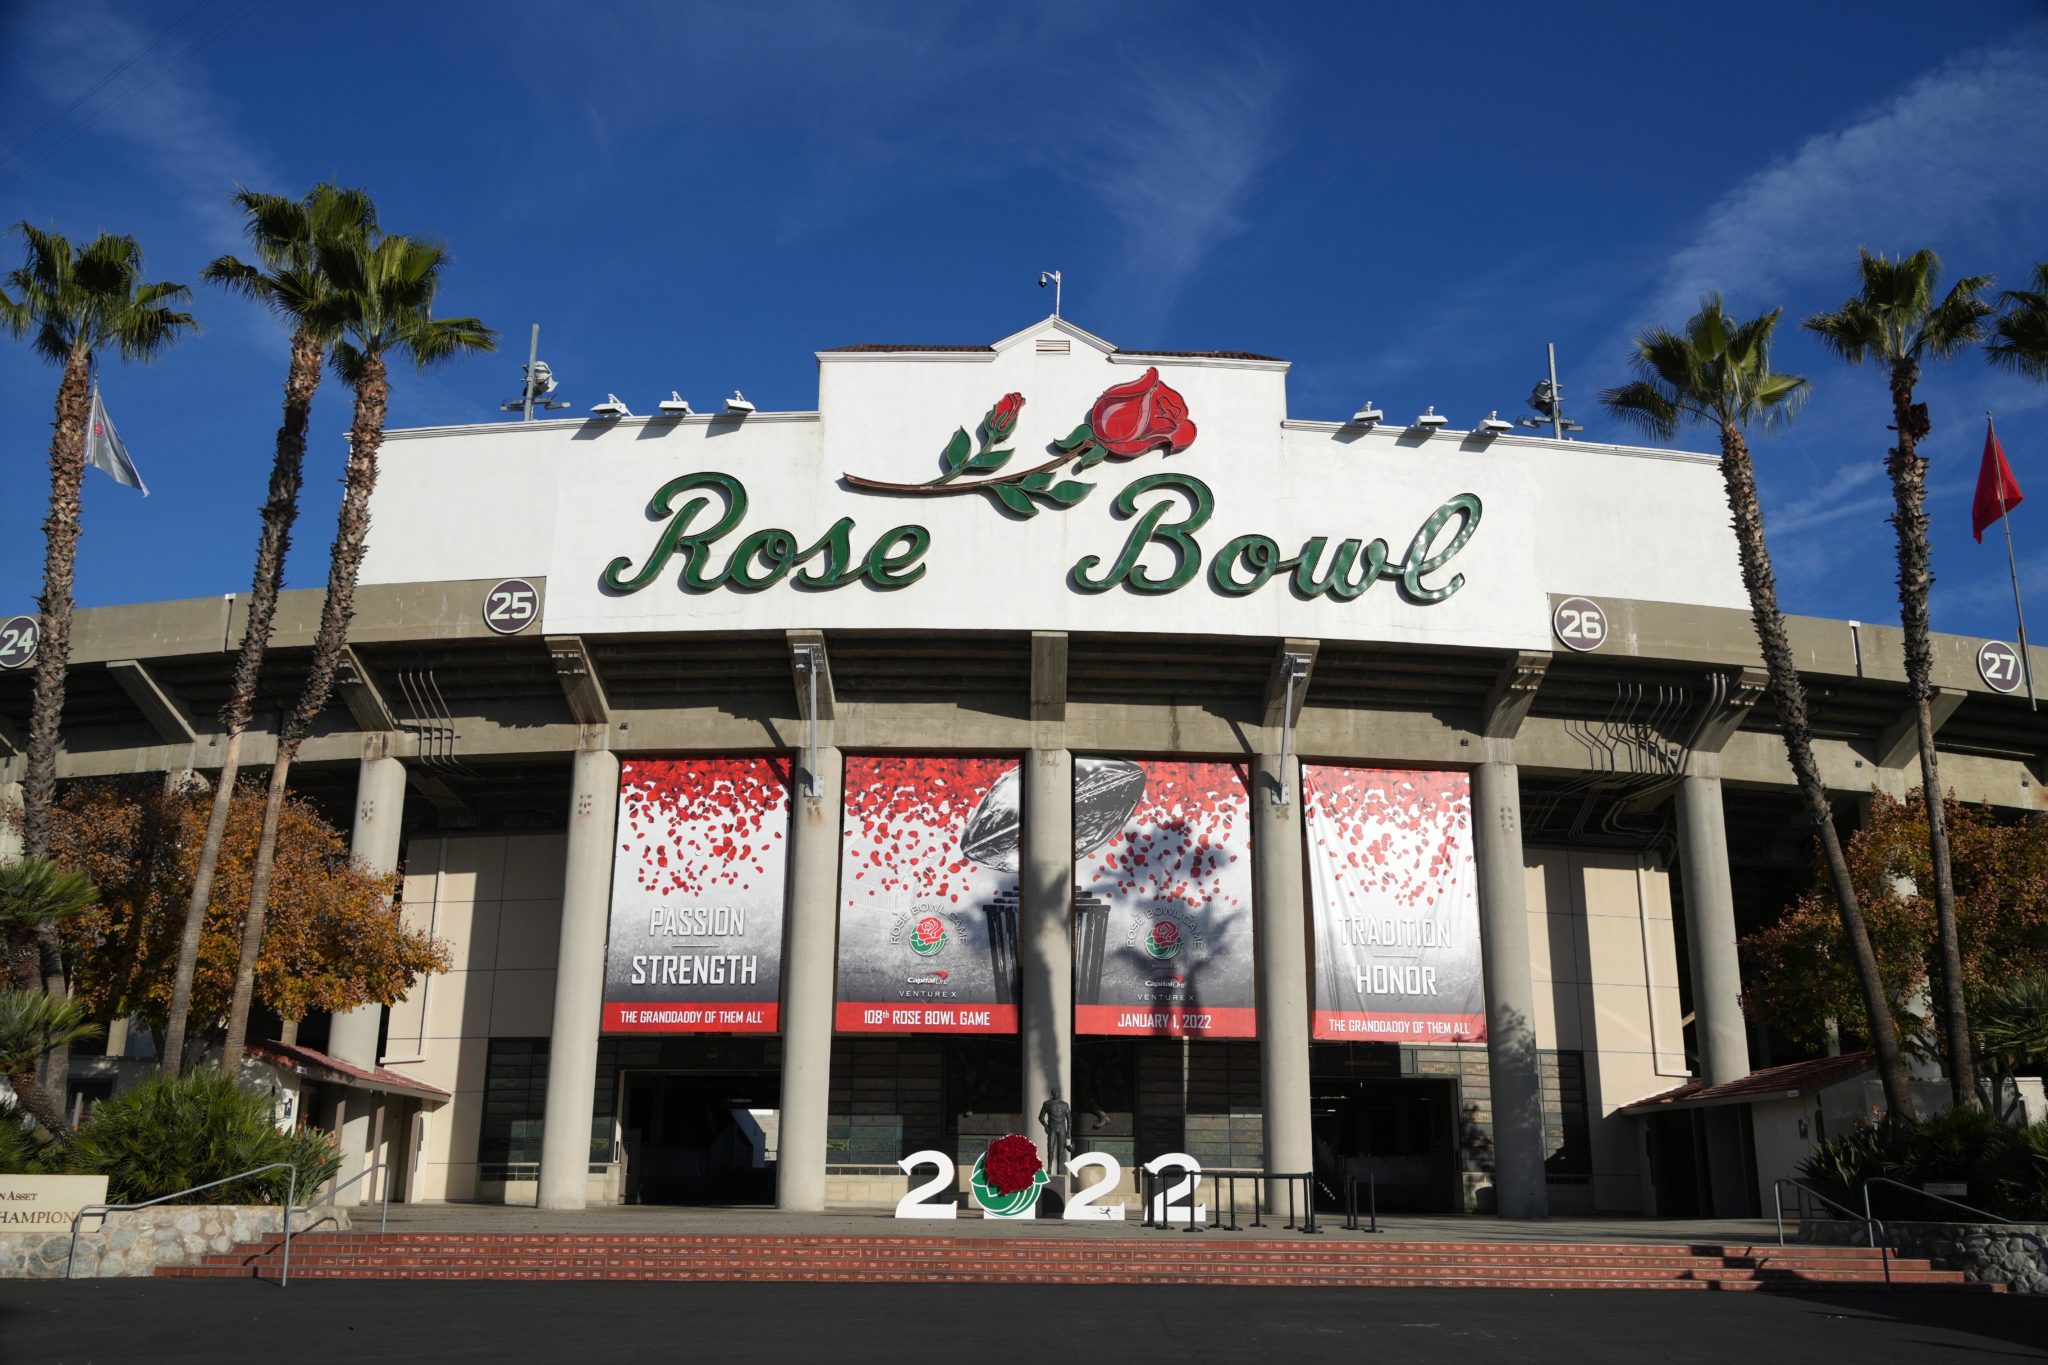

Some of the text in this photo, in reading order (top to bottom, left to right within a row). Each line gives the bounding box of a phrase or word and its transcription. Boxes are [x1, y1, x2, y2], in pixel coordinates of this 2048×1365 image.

[603, 471, 1482, 603] Rose Bowl
[489, 591, 533, 620] 25
[1560, 609, 1602, 640] 26
[0, 627, 34, 656] 24
[1983, 652, 2016, 681] 27
[649, 906, 745, 937] PASSION
[890, 903, 968, 944] ROSE BOWL GAME
[1127, 906, 1203, 949] ROSE BOWL GAME
[1339, 917, 1452, 948] TRADITION
[631, 955, 758, 985] STRENGTH
[1356, 964, 1438, 996] HONOR
[899, 990, 948, 998] VENTURE
[620, 1010, 637, 1023] THE
[640, 1010, 702, 1024] GRANDDADDY
[705, 1010, 717, 1024] OF
[719, 1011, 744, 1024] THEM
[864, 1009, 990, 1026] 108th ROSE BOWL GAME
[1117, 1013, 1212, 1030] JANUARY 1, 2022
[1328, 1018, 1346, 1032] THE
[1348, 1019, 1410, 1033] GRANDDADDY
[1412, 1021, 1424, 1034] OF
[1427, 1021, 1451, 1034] THEM
[7, 1190, 38, 1201] ASSET
